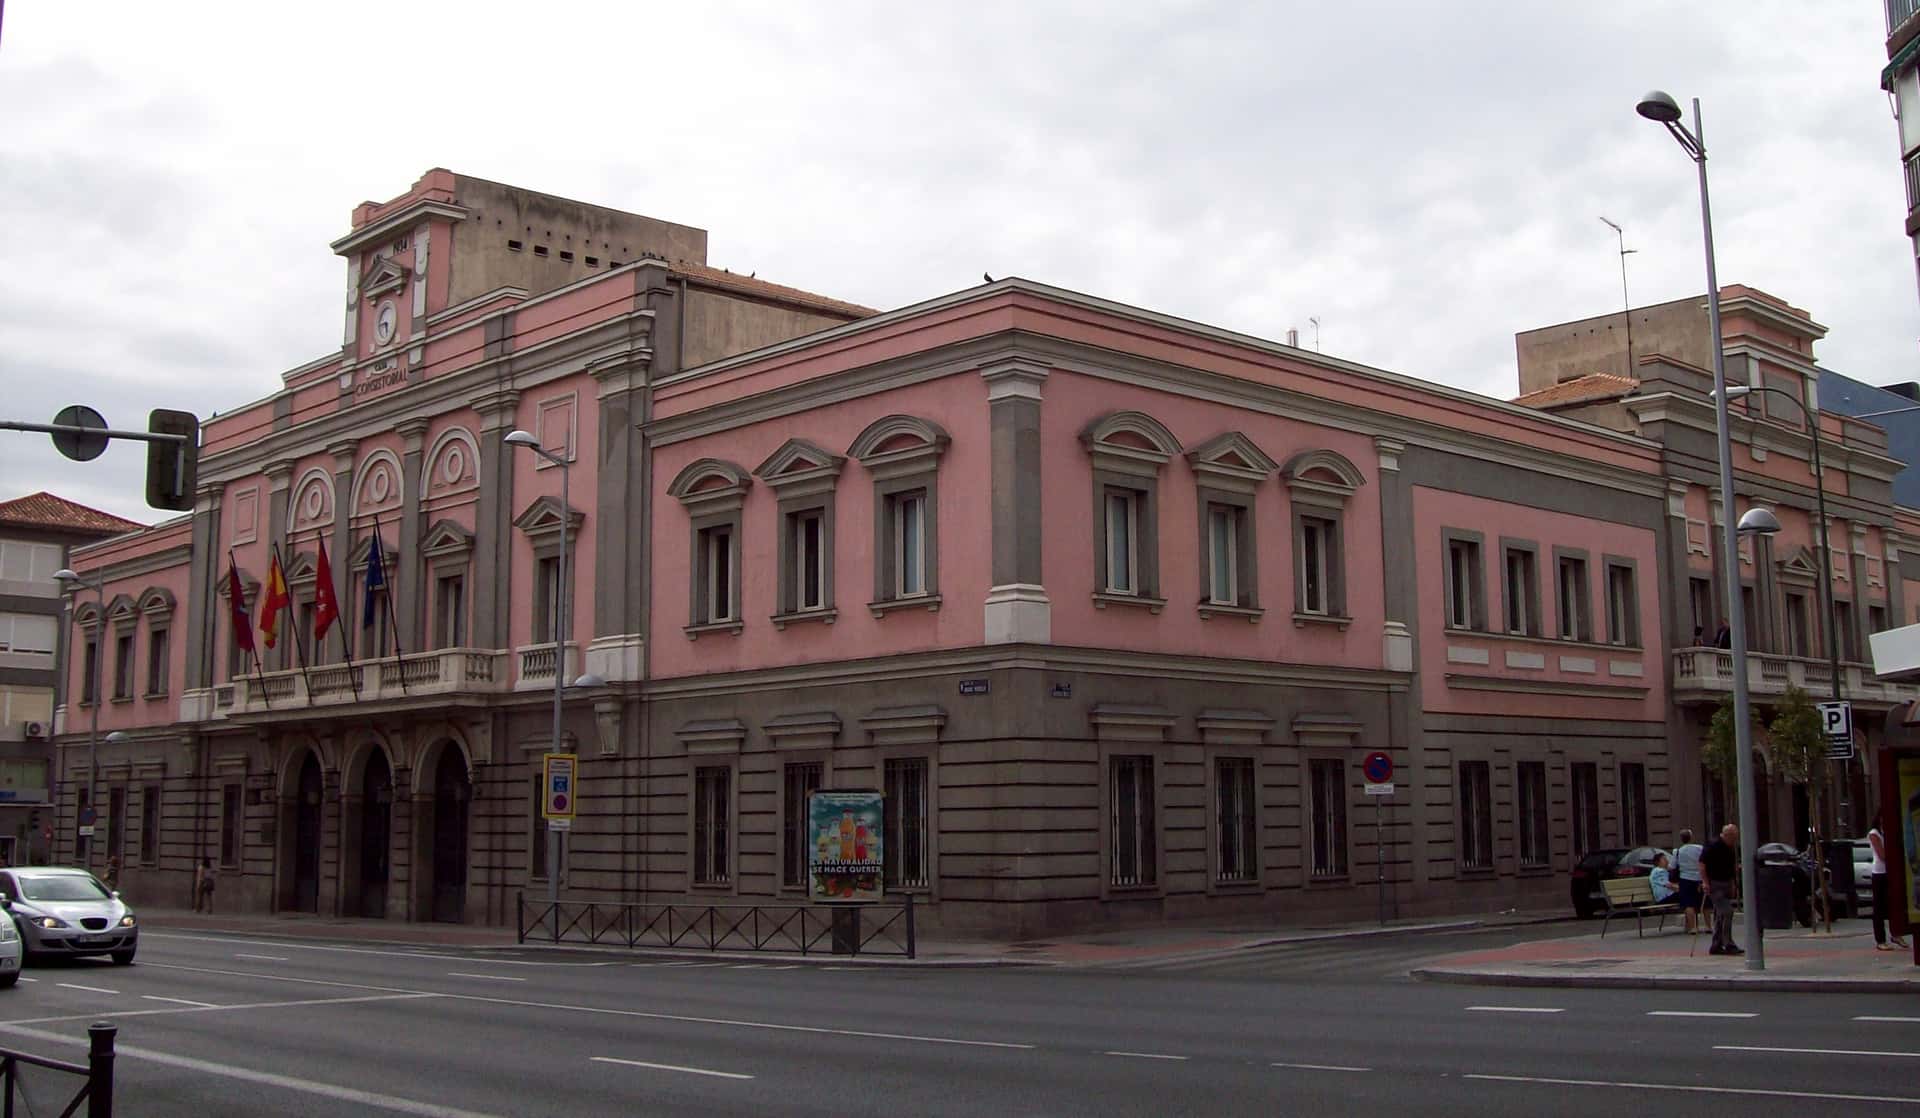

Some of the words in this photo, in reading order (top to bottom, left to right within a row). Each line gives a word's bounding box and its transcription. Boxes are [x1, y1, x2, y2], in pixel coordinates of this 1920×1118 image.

[1828, 711, 1841, 730] P
[812, 865, 822, 873] SE
[824, 865, 847, 873] HACE
[849, 865, 881, 873] QUERER
